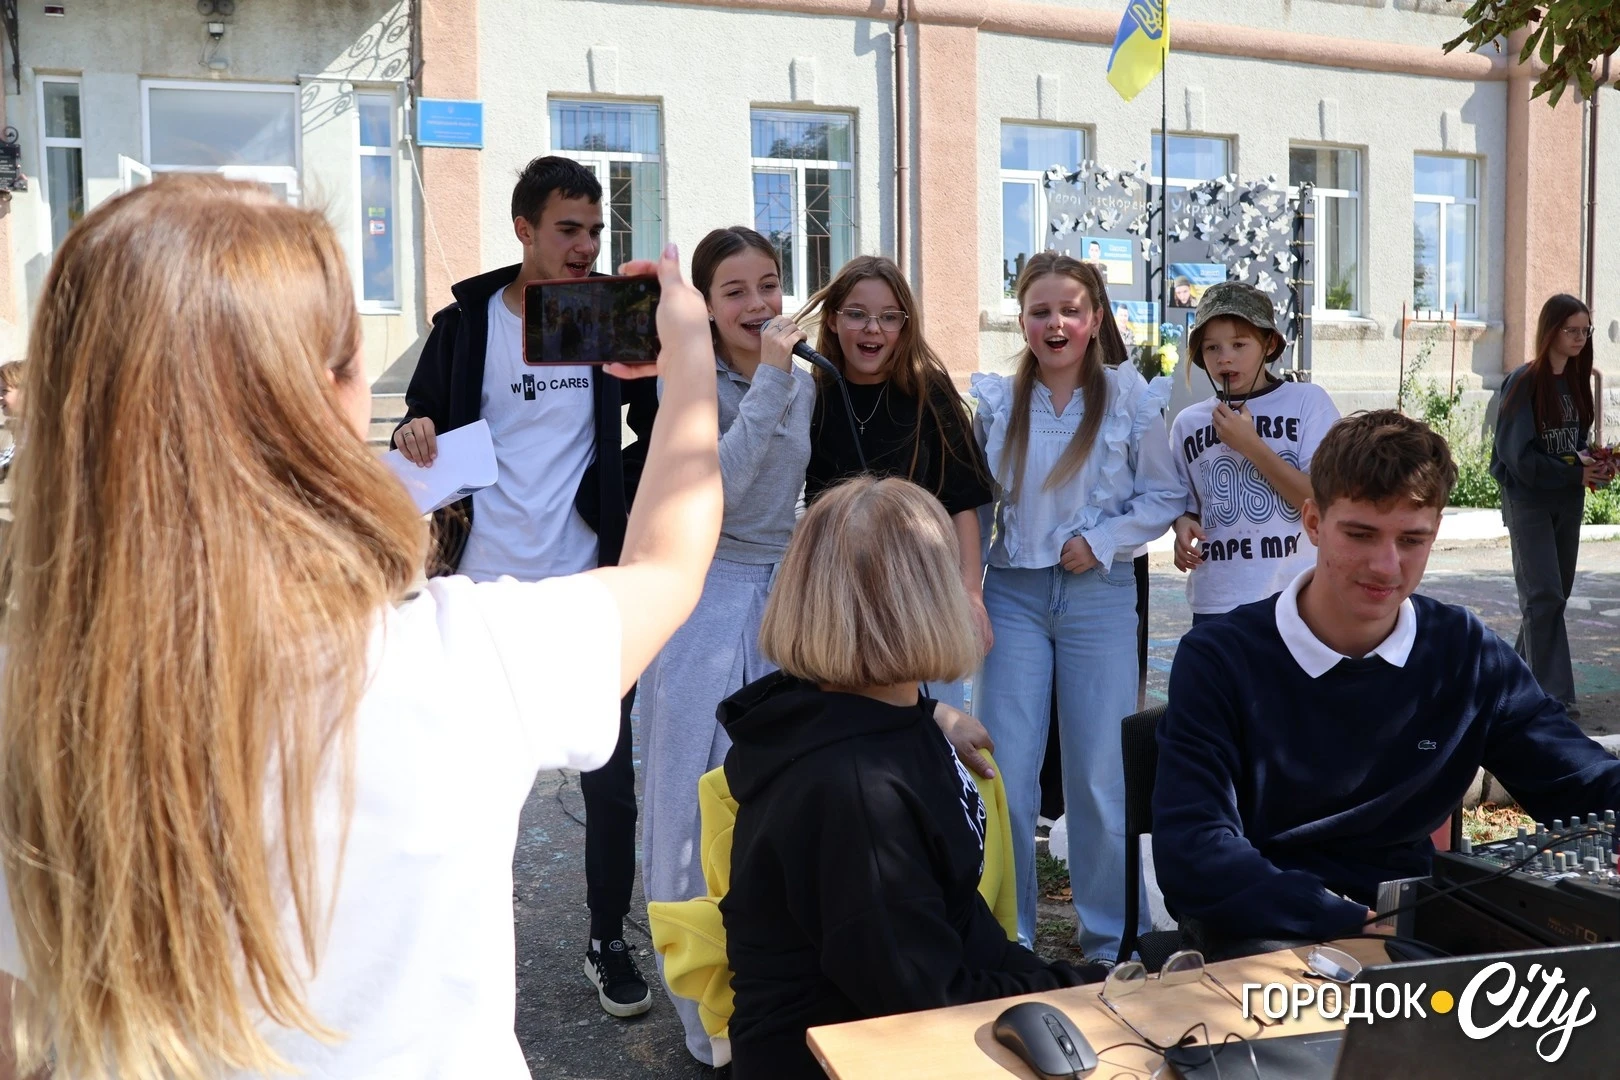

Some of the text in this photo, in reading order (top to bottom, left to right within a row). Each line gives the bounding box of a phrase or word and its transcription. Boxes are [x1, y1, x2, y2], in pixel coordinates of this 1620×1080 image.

[511, 378, 589, 394] WHO CARES
[1200, 538, 1253, 562] CAPE
